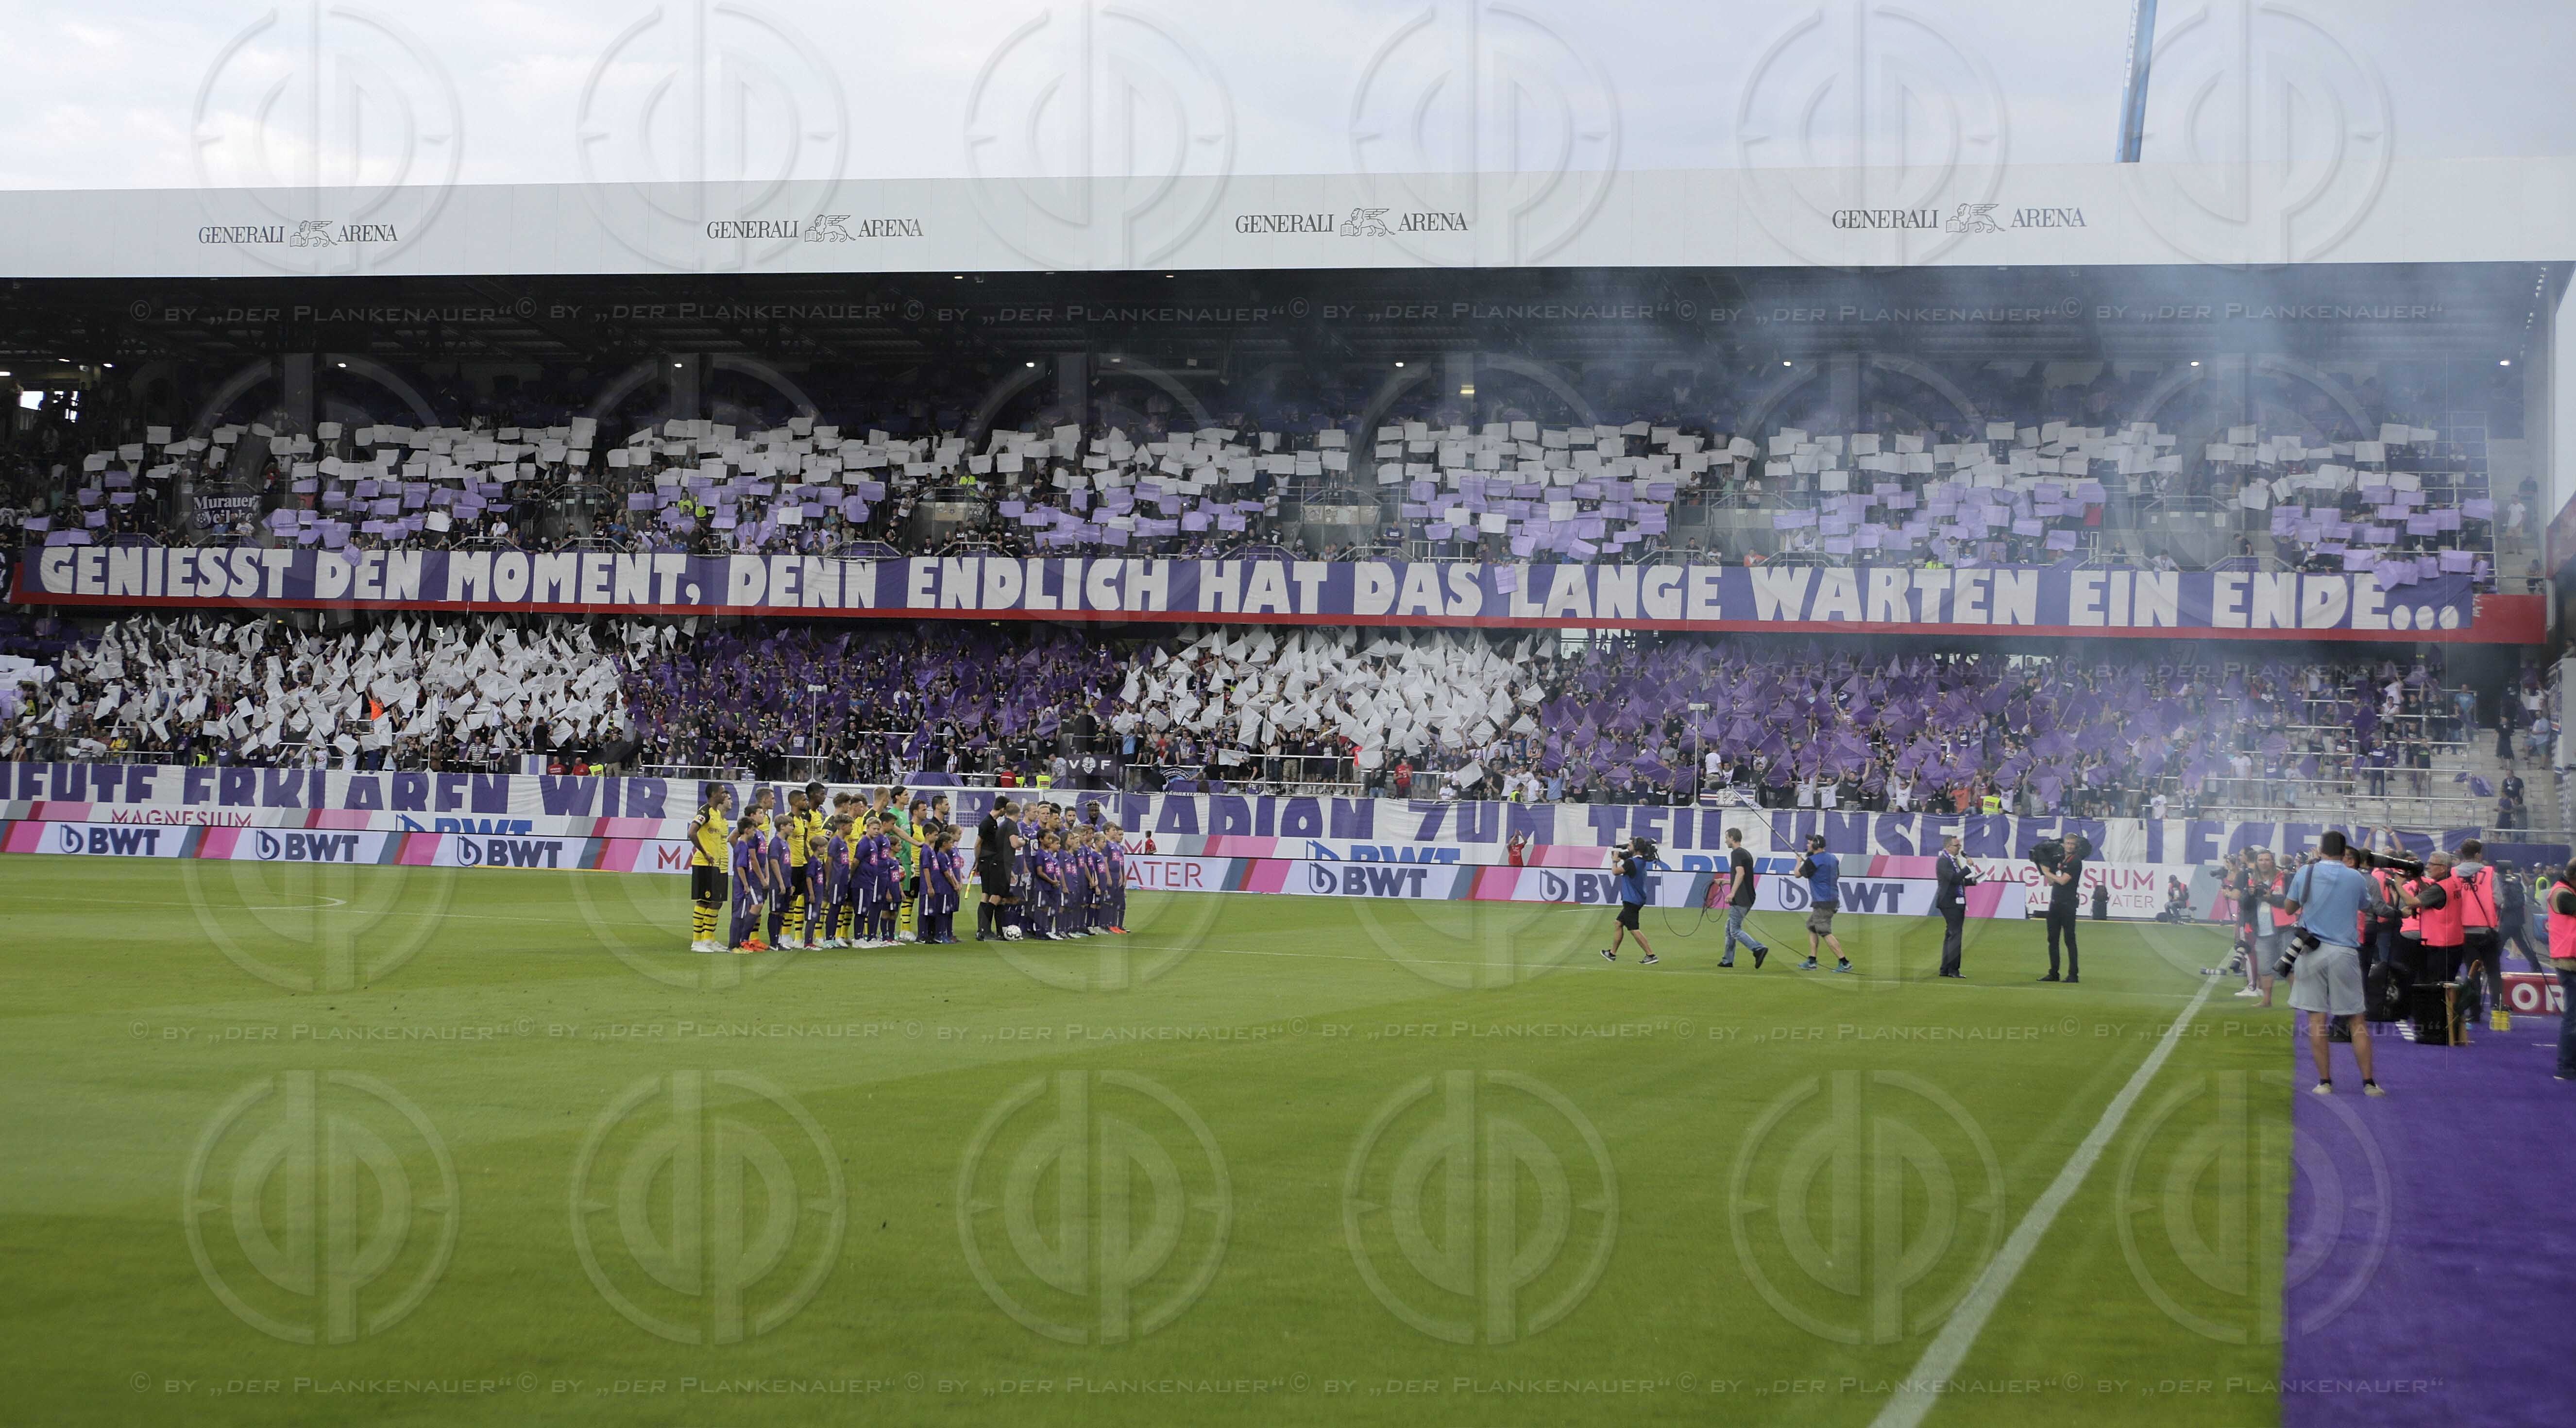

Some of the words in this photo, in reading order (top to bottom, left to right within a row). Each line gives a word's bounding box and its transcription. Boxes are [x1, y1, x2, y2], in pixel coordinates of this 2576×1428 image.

[707, 221, 798, 238] GENERALI
[858, 219, 924, 237] ARENA
[1236, 214, 1334, 233] GENERALI
[1398, 213, 1468, 231] ARENA
[1832, 210, 1939, 229] GENERALI
[2010, 208, 2087, 227] ARENA
[199, 226, 285, 243] GENERALI
[337, 224, 398, 242] ARENA
[193, 496, 254, 509] Murauer
[40, 546, 292, 598] GENIESST
[314, 549, 423, 600] DEN
[446, 551, 701, 606] MOMENT,
[727, 555, 876, 609] DENN
[907, 557, 1169, 611] ENDLICH
[1197, 560, 1327, 614] HAT
[1354, 561, 1483, 616] DAS
[1508, 563, 1722, 620] LANGE
[1749, 566, 2038, 626] WARTEN
[2068, 570, 2179, 627] EIN
[2212, 572, 2459, 630] ENDE...
[539, 775, 667, 818] WIR
[88, 827, 160, 857] BWT
[285, 833, 359, 862] BWT
[487, 839, 562, 868] BWT
[1124, 860, 1203, 888] ATER
[1343, 866, 1427, 898] BWT
[1838, 882, 1904, 914] WT
